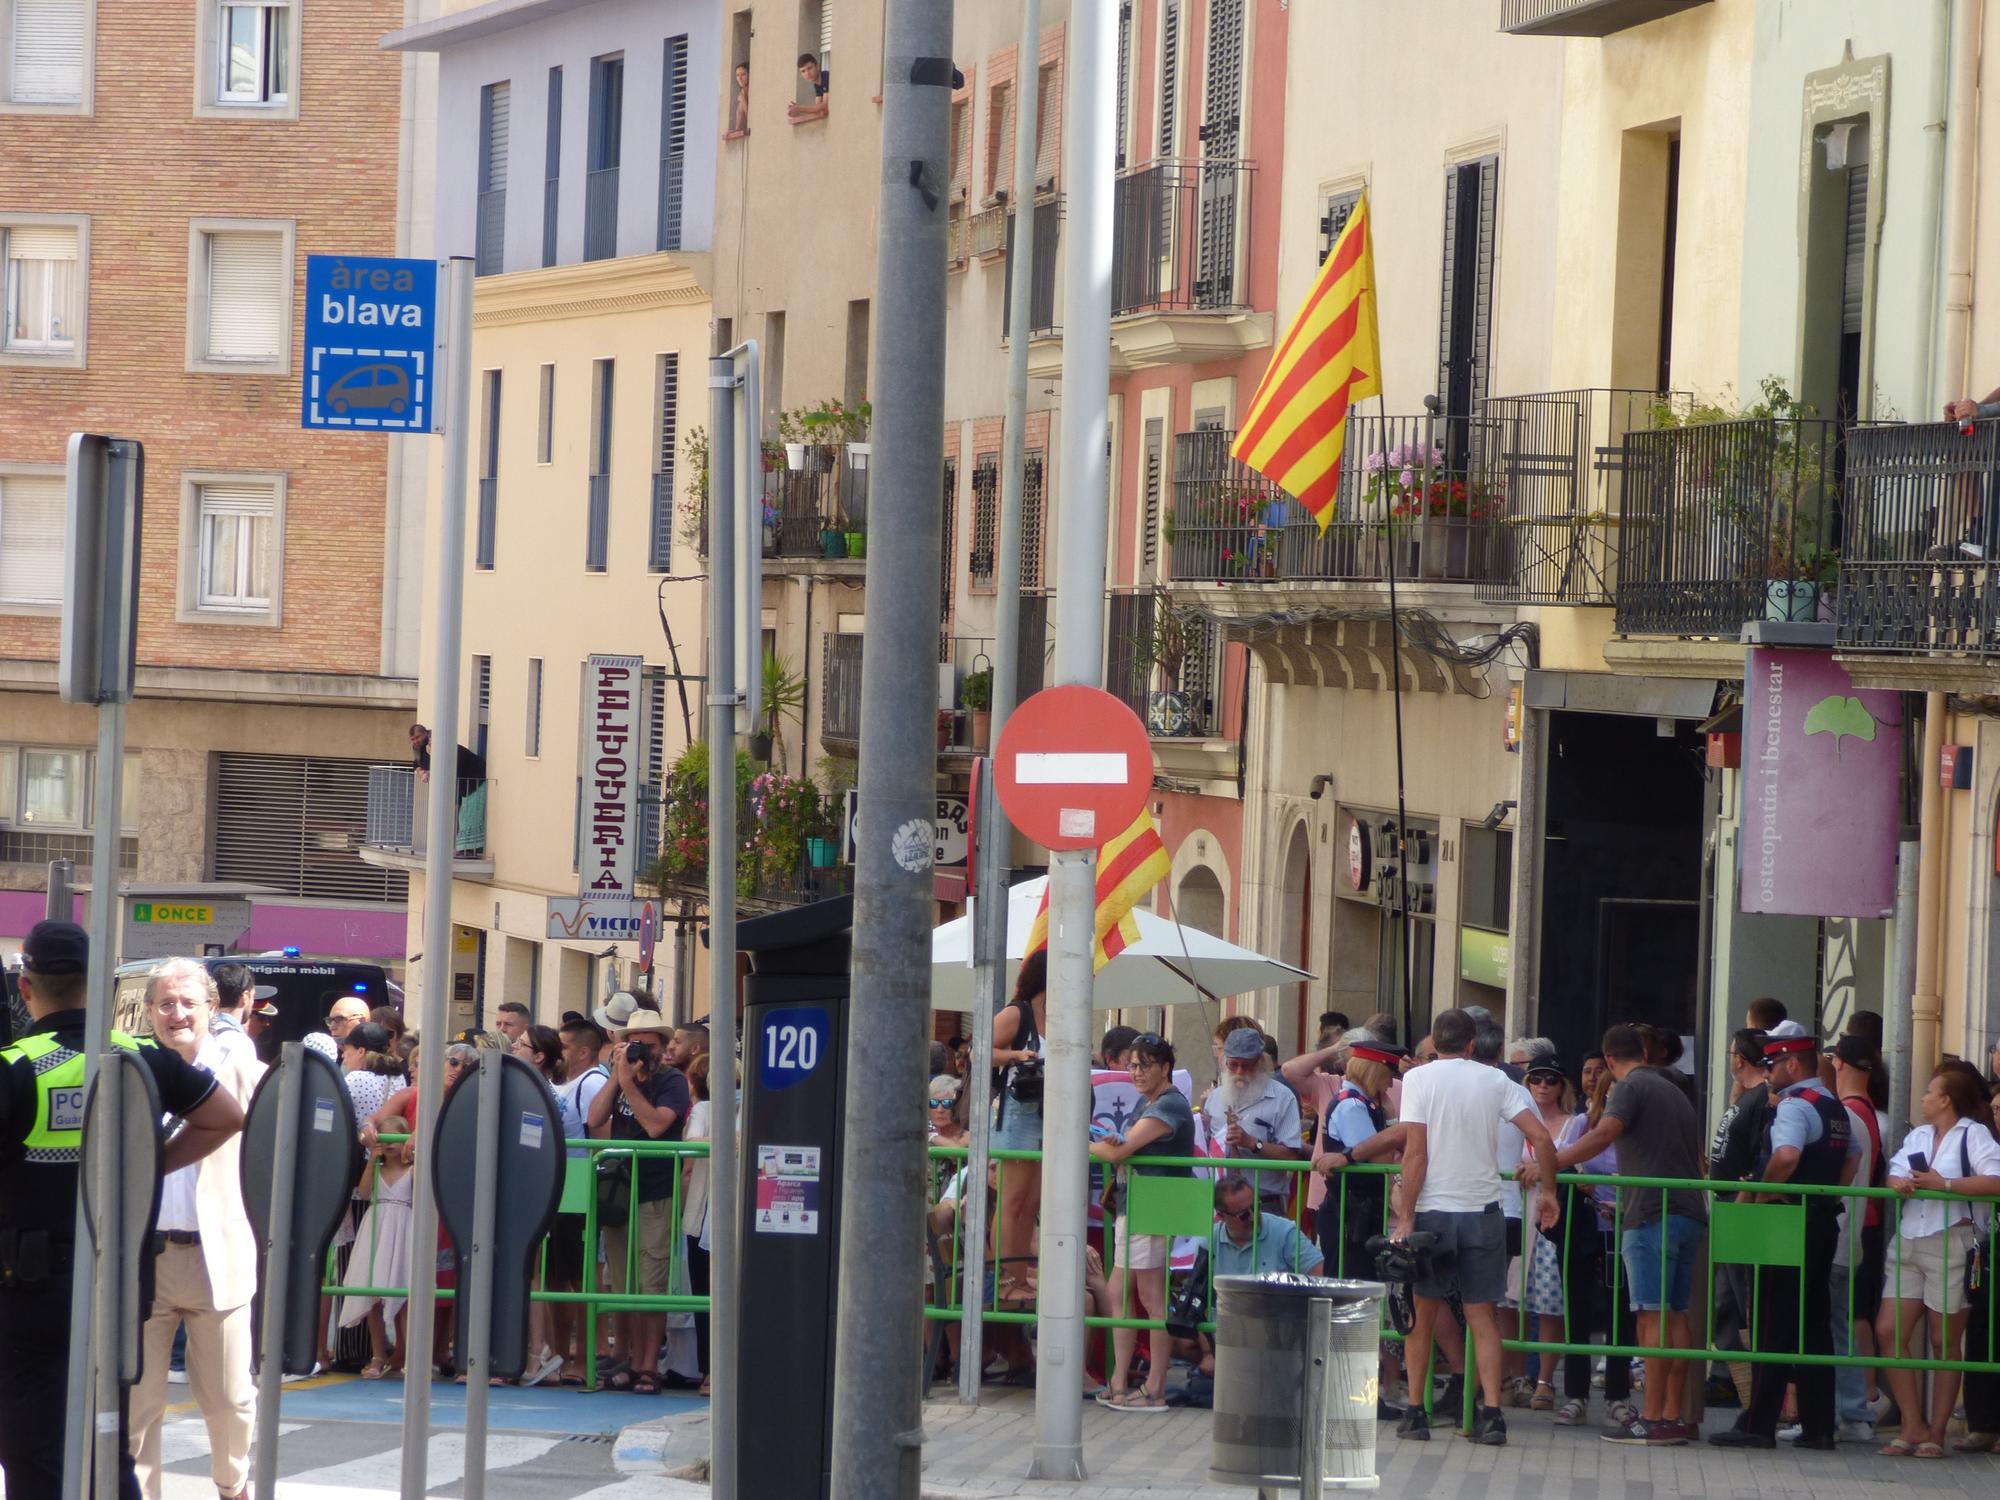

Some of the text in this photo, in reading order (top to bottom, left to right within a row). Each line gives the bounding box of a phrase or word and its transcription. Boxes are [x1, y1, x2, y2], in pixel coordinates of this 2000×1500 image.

[331, 259, 414, 292] àrea
[322, 294, 422, 327] blava
[1761, 661, 1784, 762] benestar
[590, 667, 630, 890] PELUQUERIA
[1759, 783, 1782, 903] osteopatia
[158, 906, 207, 921] ONCE
[588, 917, 641, 931] VICTO
[300, 965, 335, 975] mòbil
[766, 1025, 817, 1070] 120
[56, 1092, 83, 1110] PO
